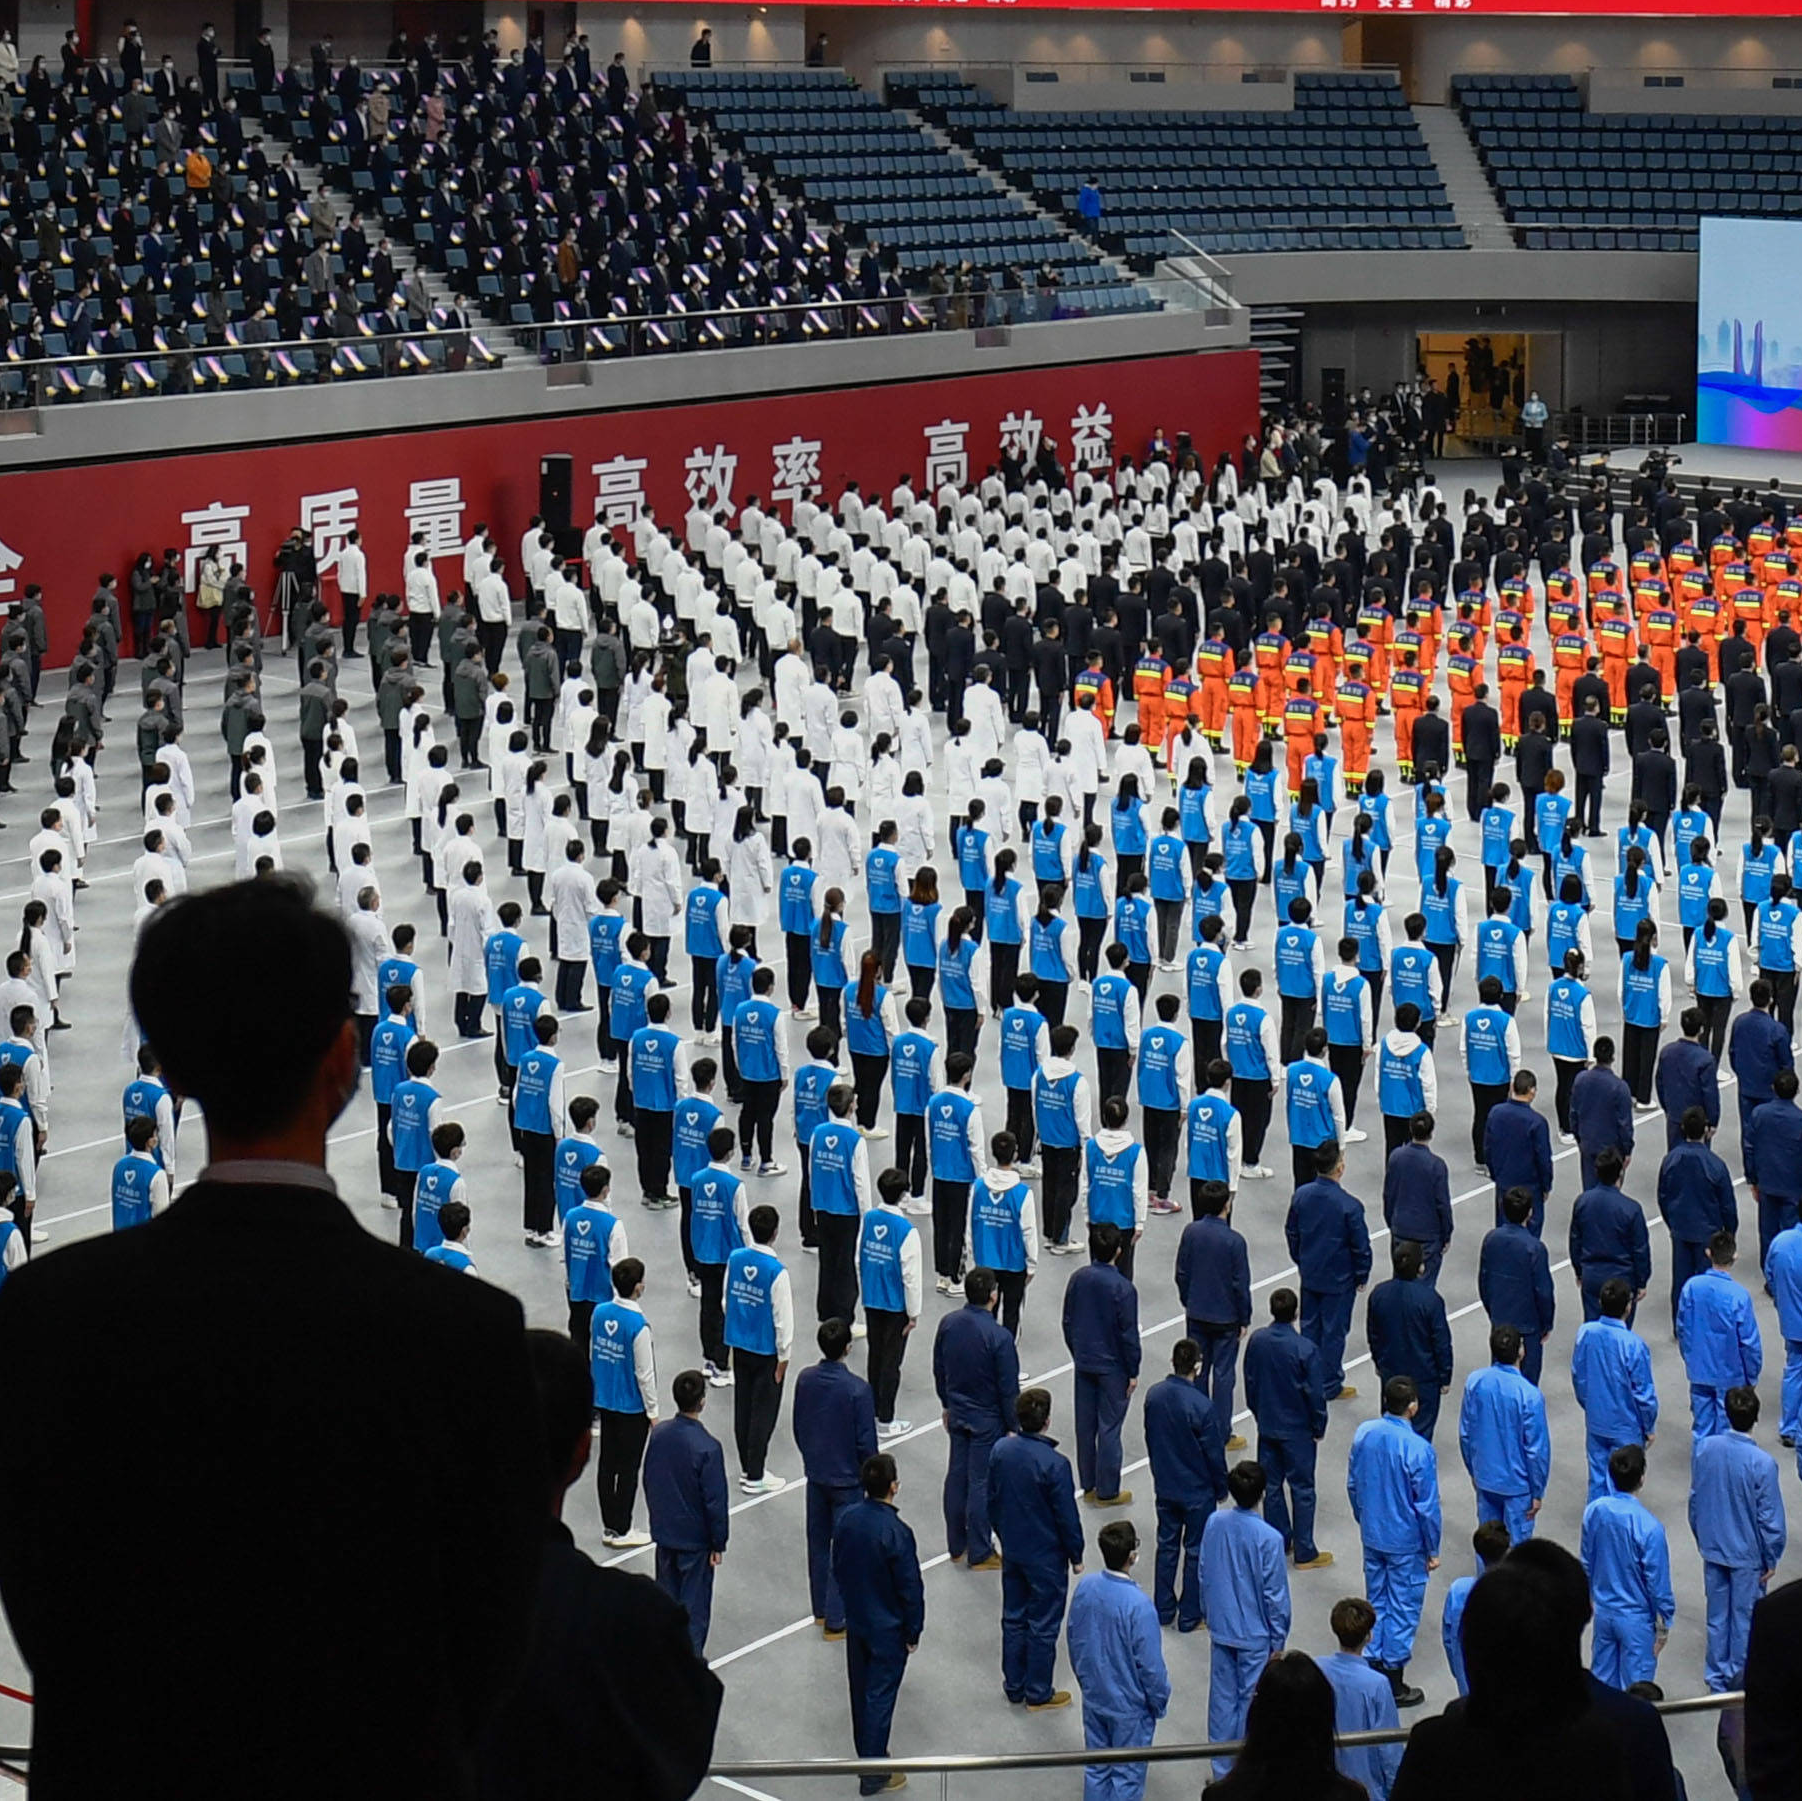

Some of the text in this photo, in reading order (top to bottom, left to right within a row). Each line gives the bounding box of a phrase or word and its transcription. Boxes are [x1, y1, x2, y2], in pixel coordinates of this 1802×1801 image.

[181, 476, 467, 594] 高质量
[591, 435, 822, 533] 高效率
